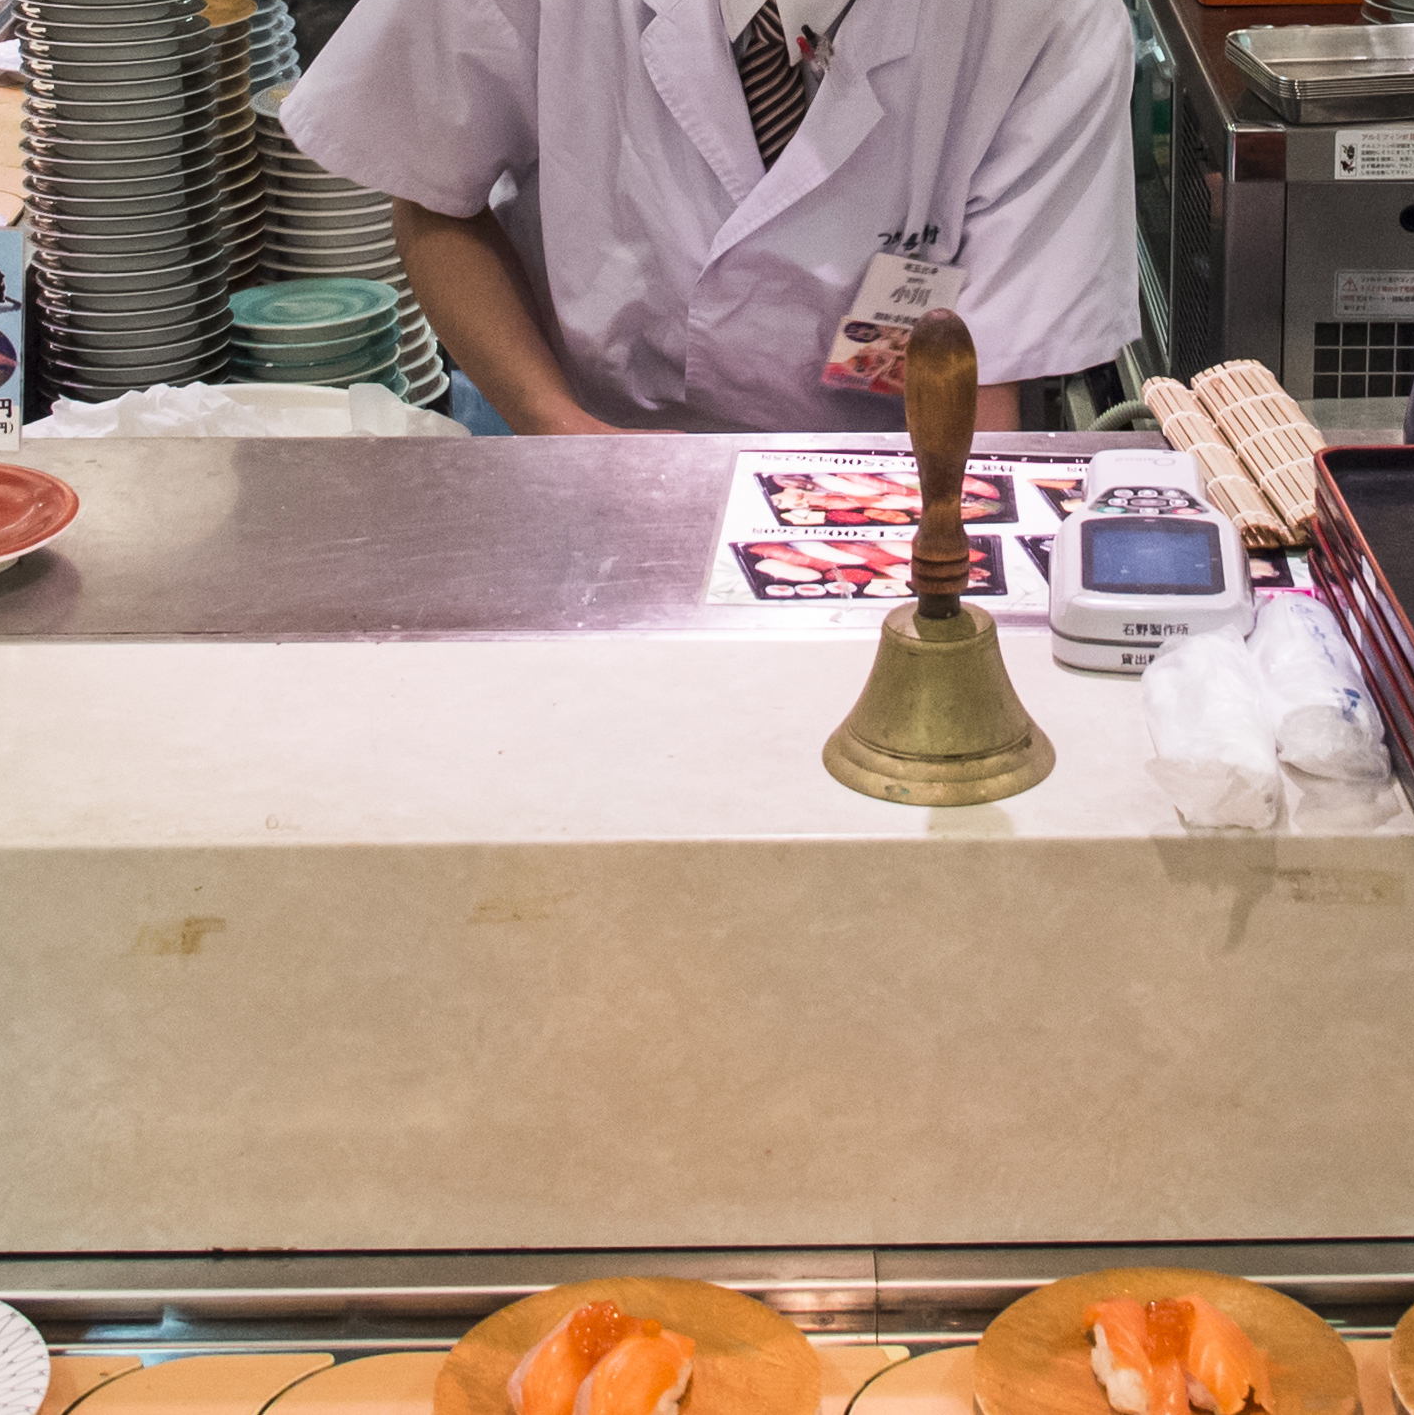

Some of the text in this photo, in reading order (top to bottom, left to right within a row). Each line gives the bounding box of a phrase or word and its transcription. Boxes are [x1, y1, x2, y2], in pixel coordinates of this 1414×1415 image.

[889, 285, 933, 308] 小川
[1122, 623, 1190, 636] 石野製作所
